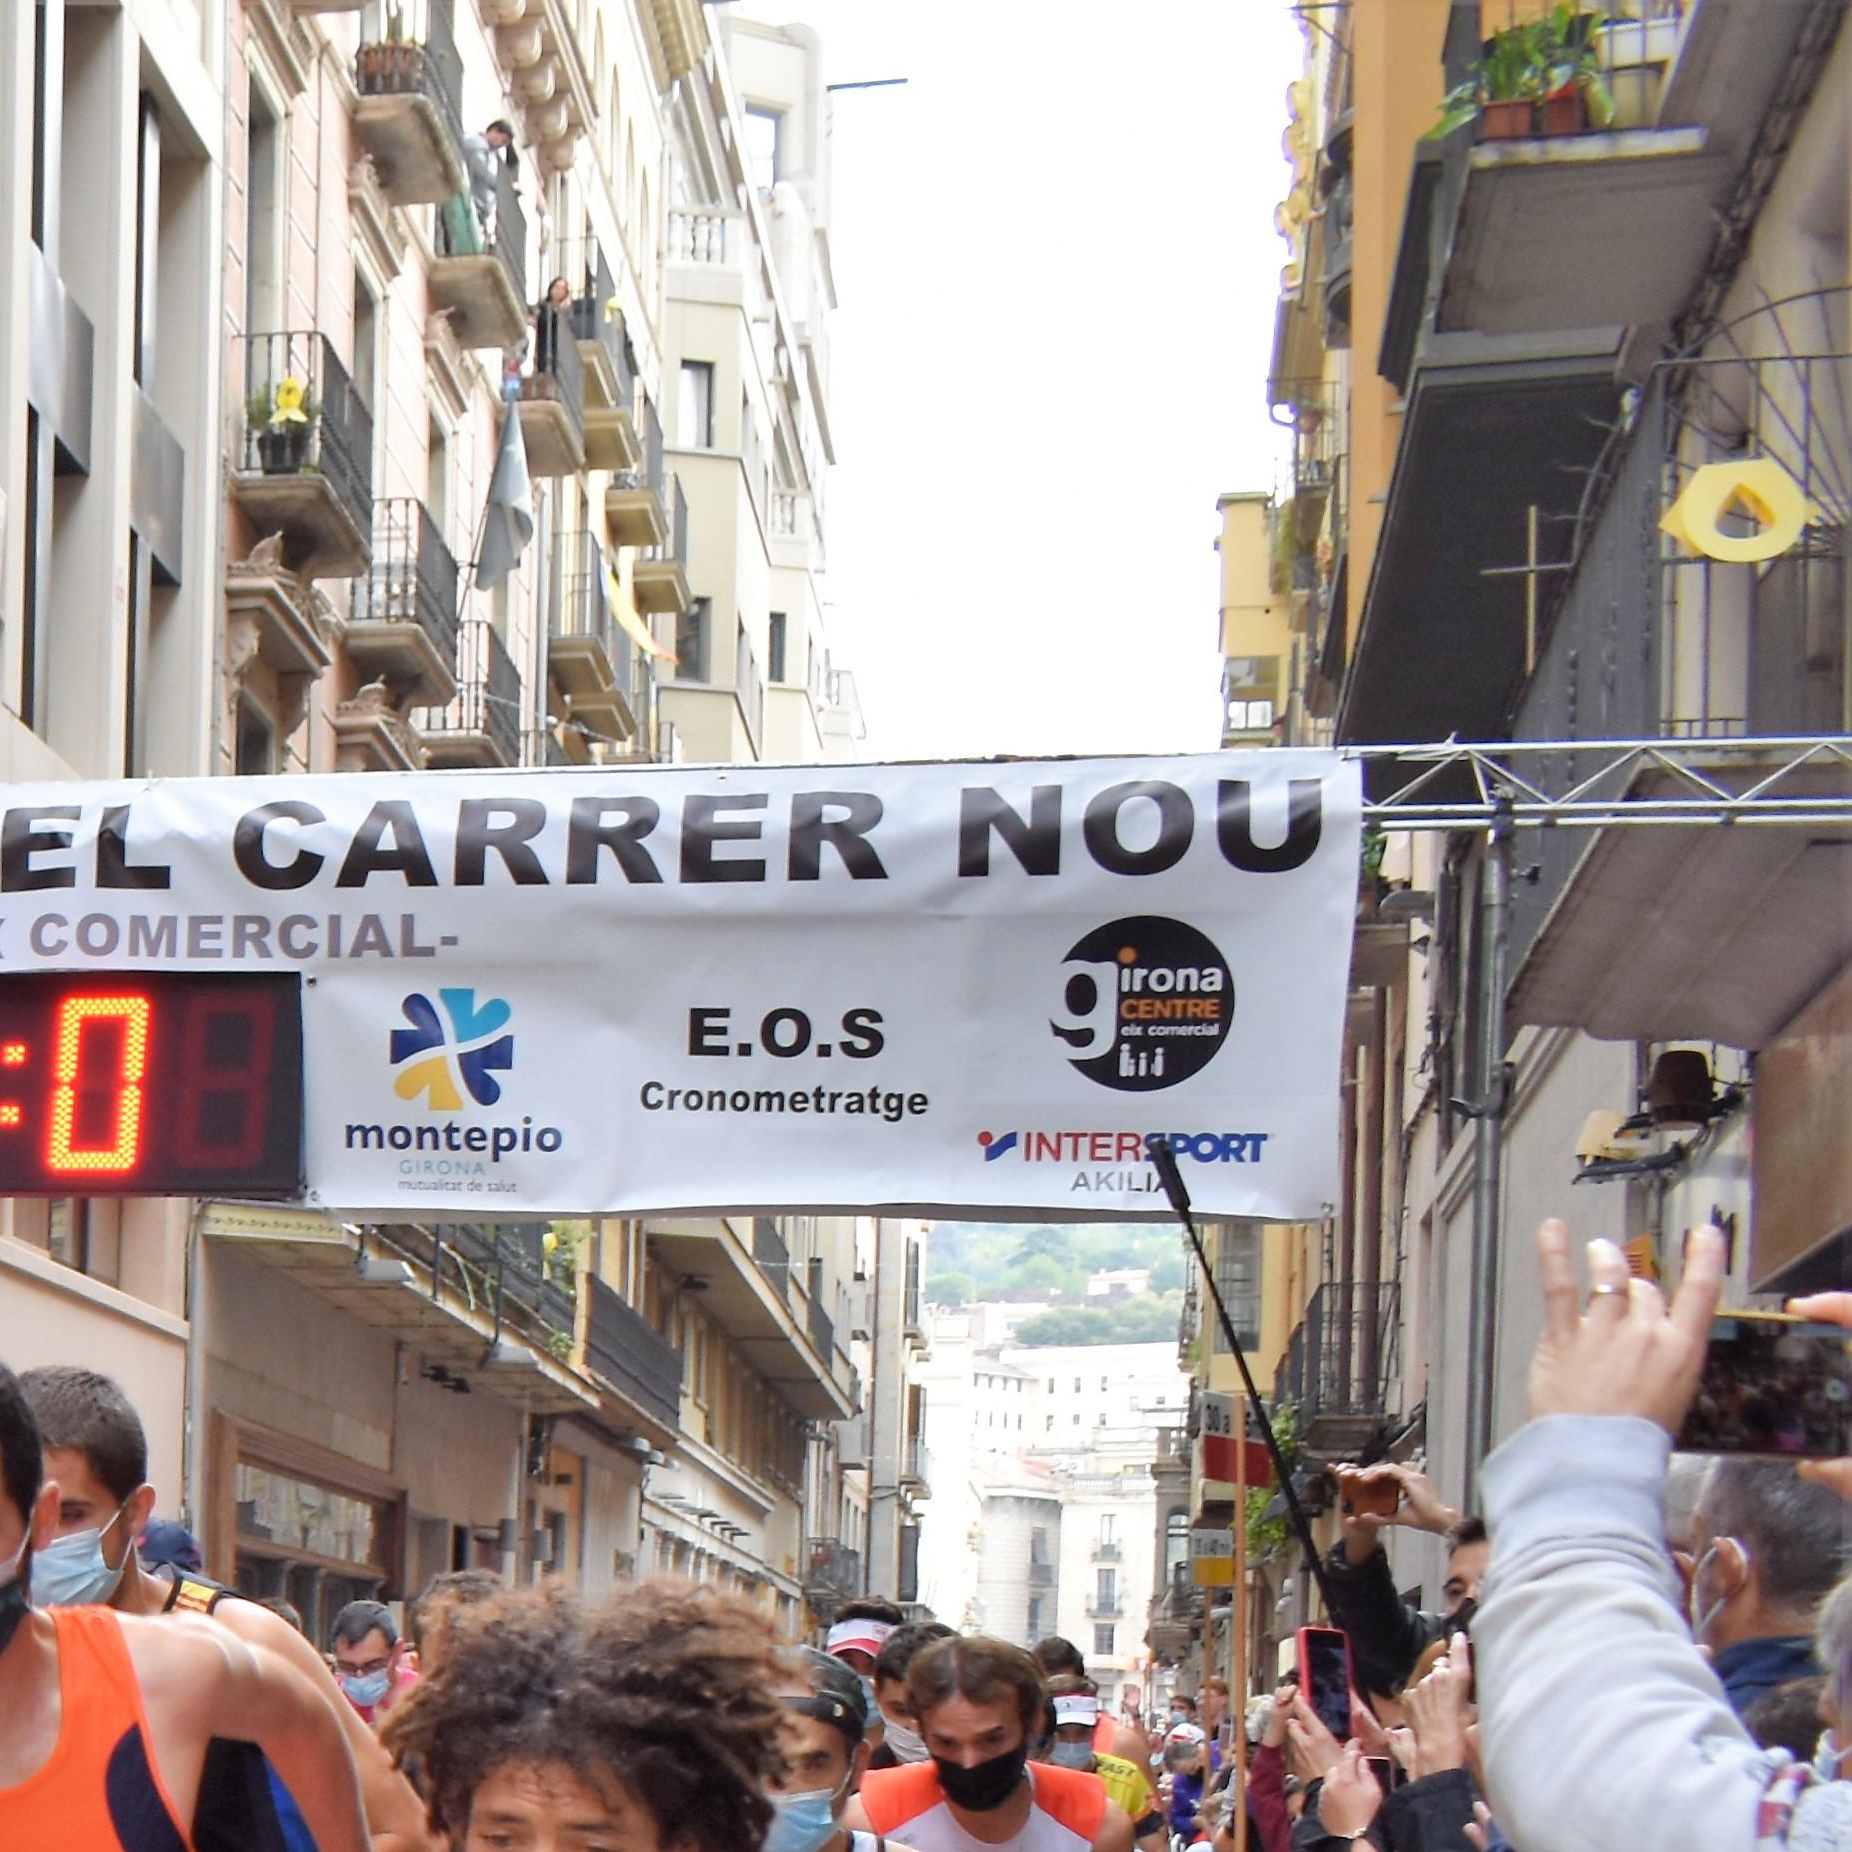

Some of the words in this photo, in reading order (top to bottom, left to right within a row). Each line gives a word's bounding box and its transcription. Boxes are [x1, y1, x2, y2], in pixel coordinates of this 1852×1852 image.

[232, 791, 890, 891] CARRER
[957, 777, 1324, 878] NOU
[29, 911, 460, 960] COMERCIAL-
[1121, 998, 1221, 1020] CENTRE
[687, 1006, 885, 1061] E.O.S
[1120, 1024, 1143, 1037] eix
[1147, 1022, 1220, 1037] comercial
[639, 1080, 930, 1123] Cronometratge
[343, 1114, 564, 1163] montepio
[1024, 1131, 1269, 1164] INTERSPORT
[398, 1159, 487, 1176] GIRONA
[398, 1177, 463, 1193] mutualitat
[466, 1178, 483, 1193] de
[486, 1178, 518, 1193] salut
